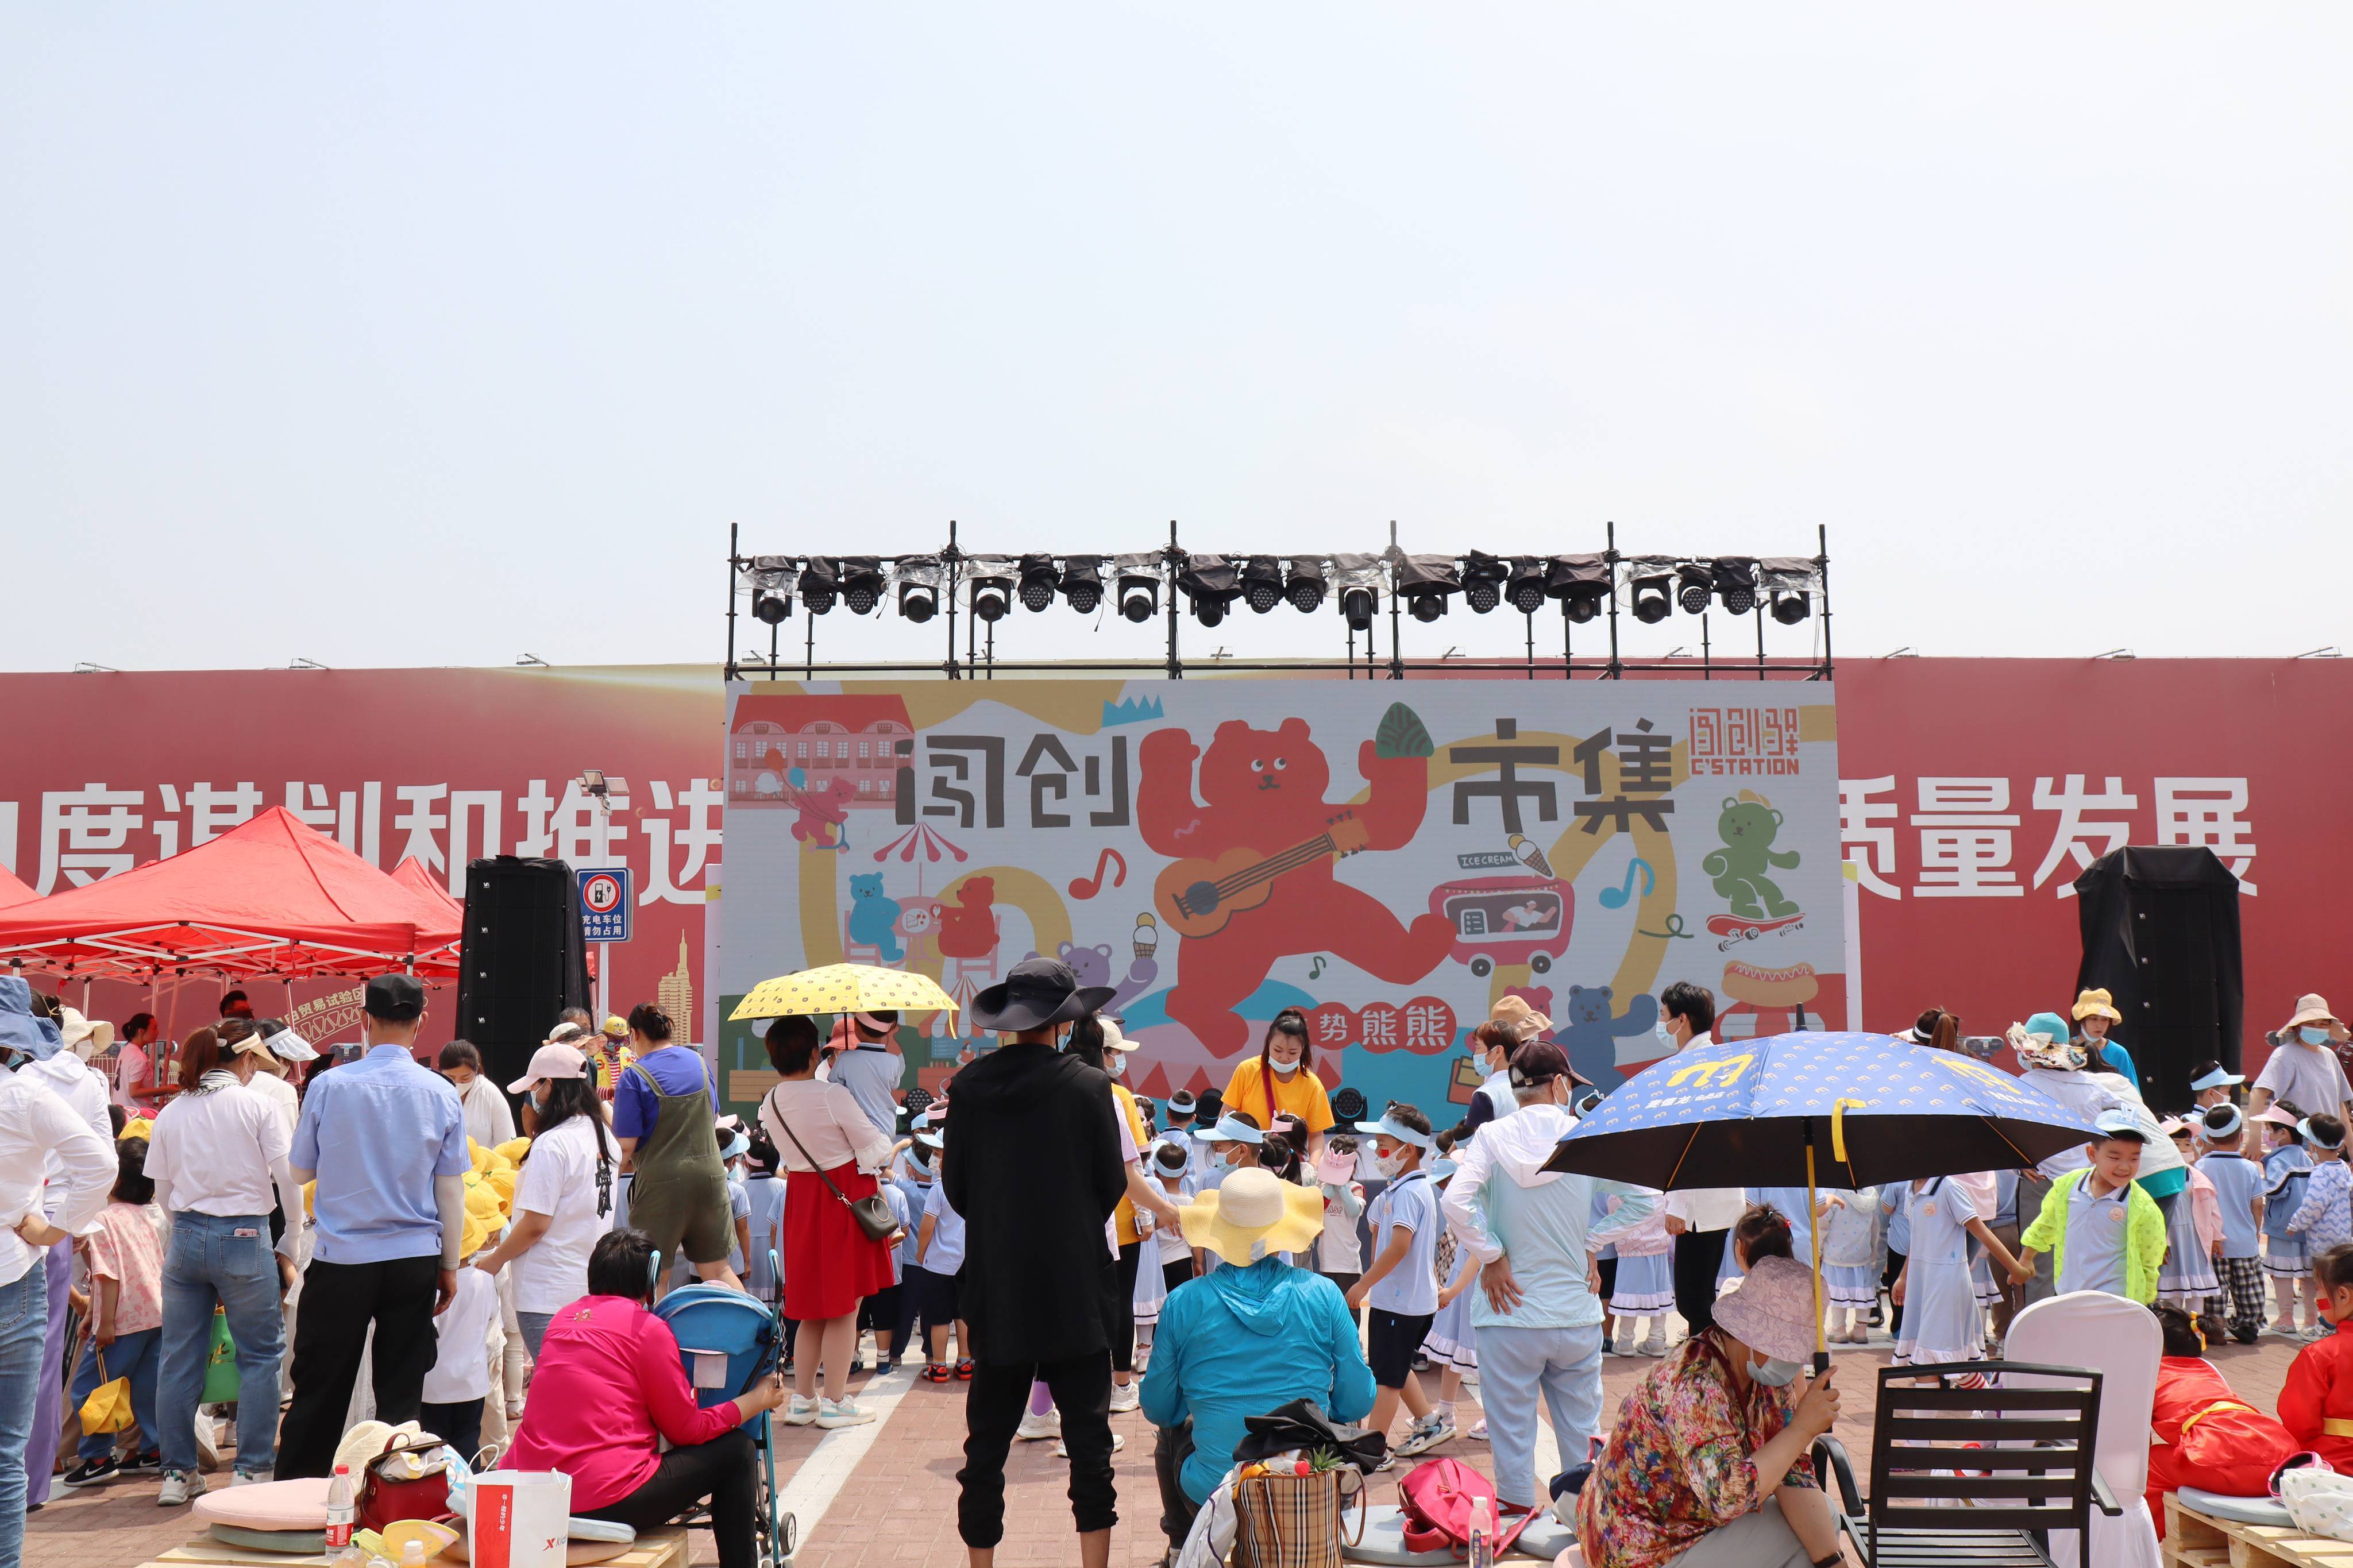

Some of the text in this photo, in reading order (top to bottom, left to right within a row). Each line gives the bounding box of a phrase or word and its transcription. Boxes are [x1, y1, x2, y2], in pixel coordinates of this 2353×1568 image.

[1691, 759, 1799, 775] C'STATION
[894, 717, 1675, 835] 闯创 市集
[1461, 855, 1514, 866] ICE CREAM
[582, 914, 622, 925] 充电车位
